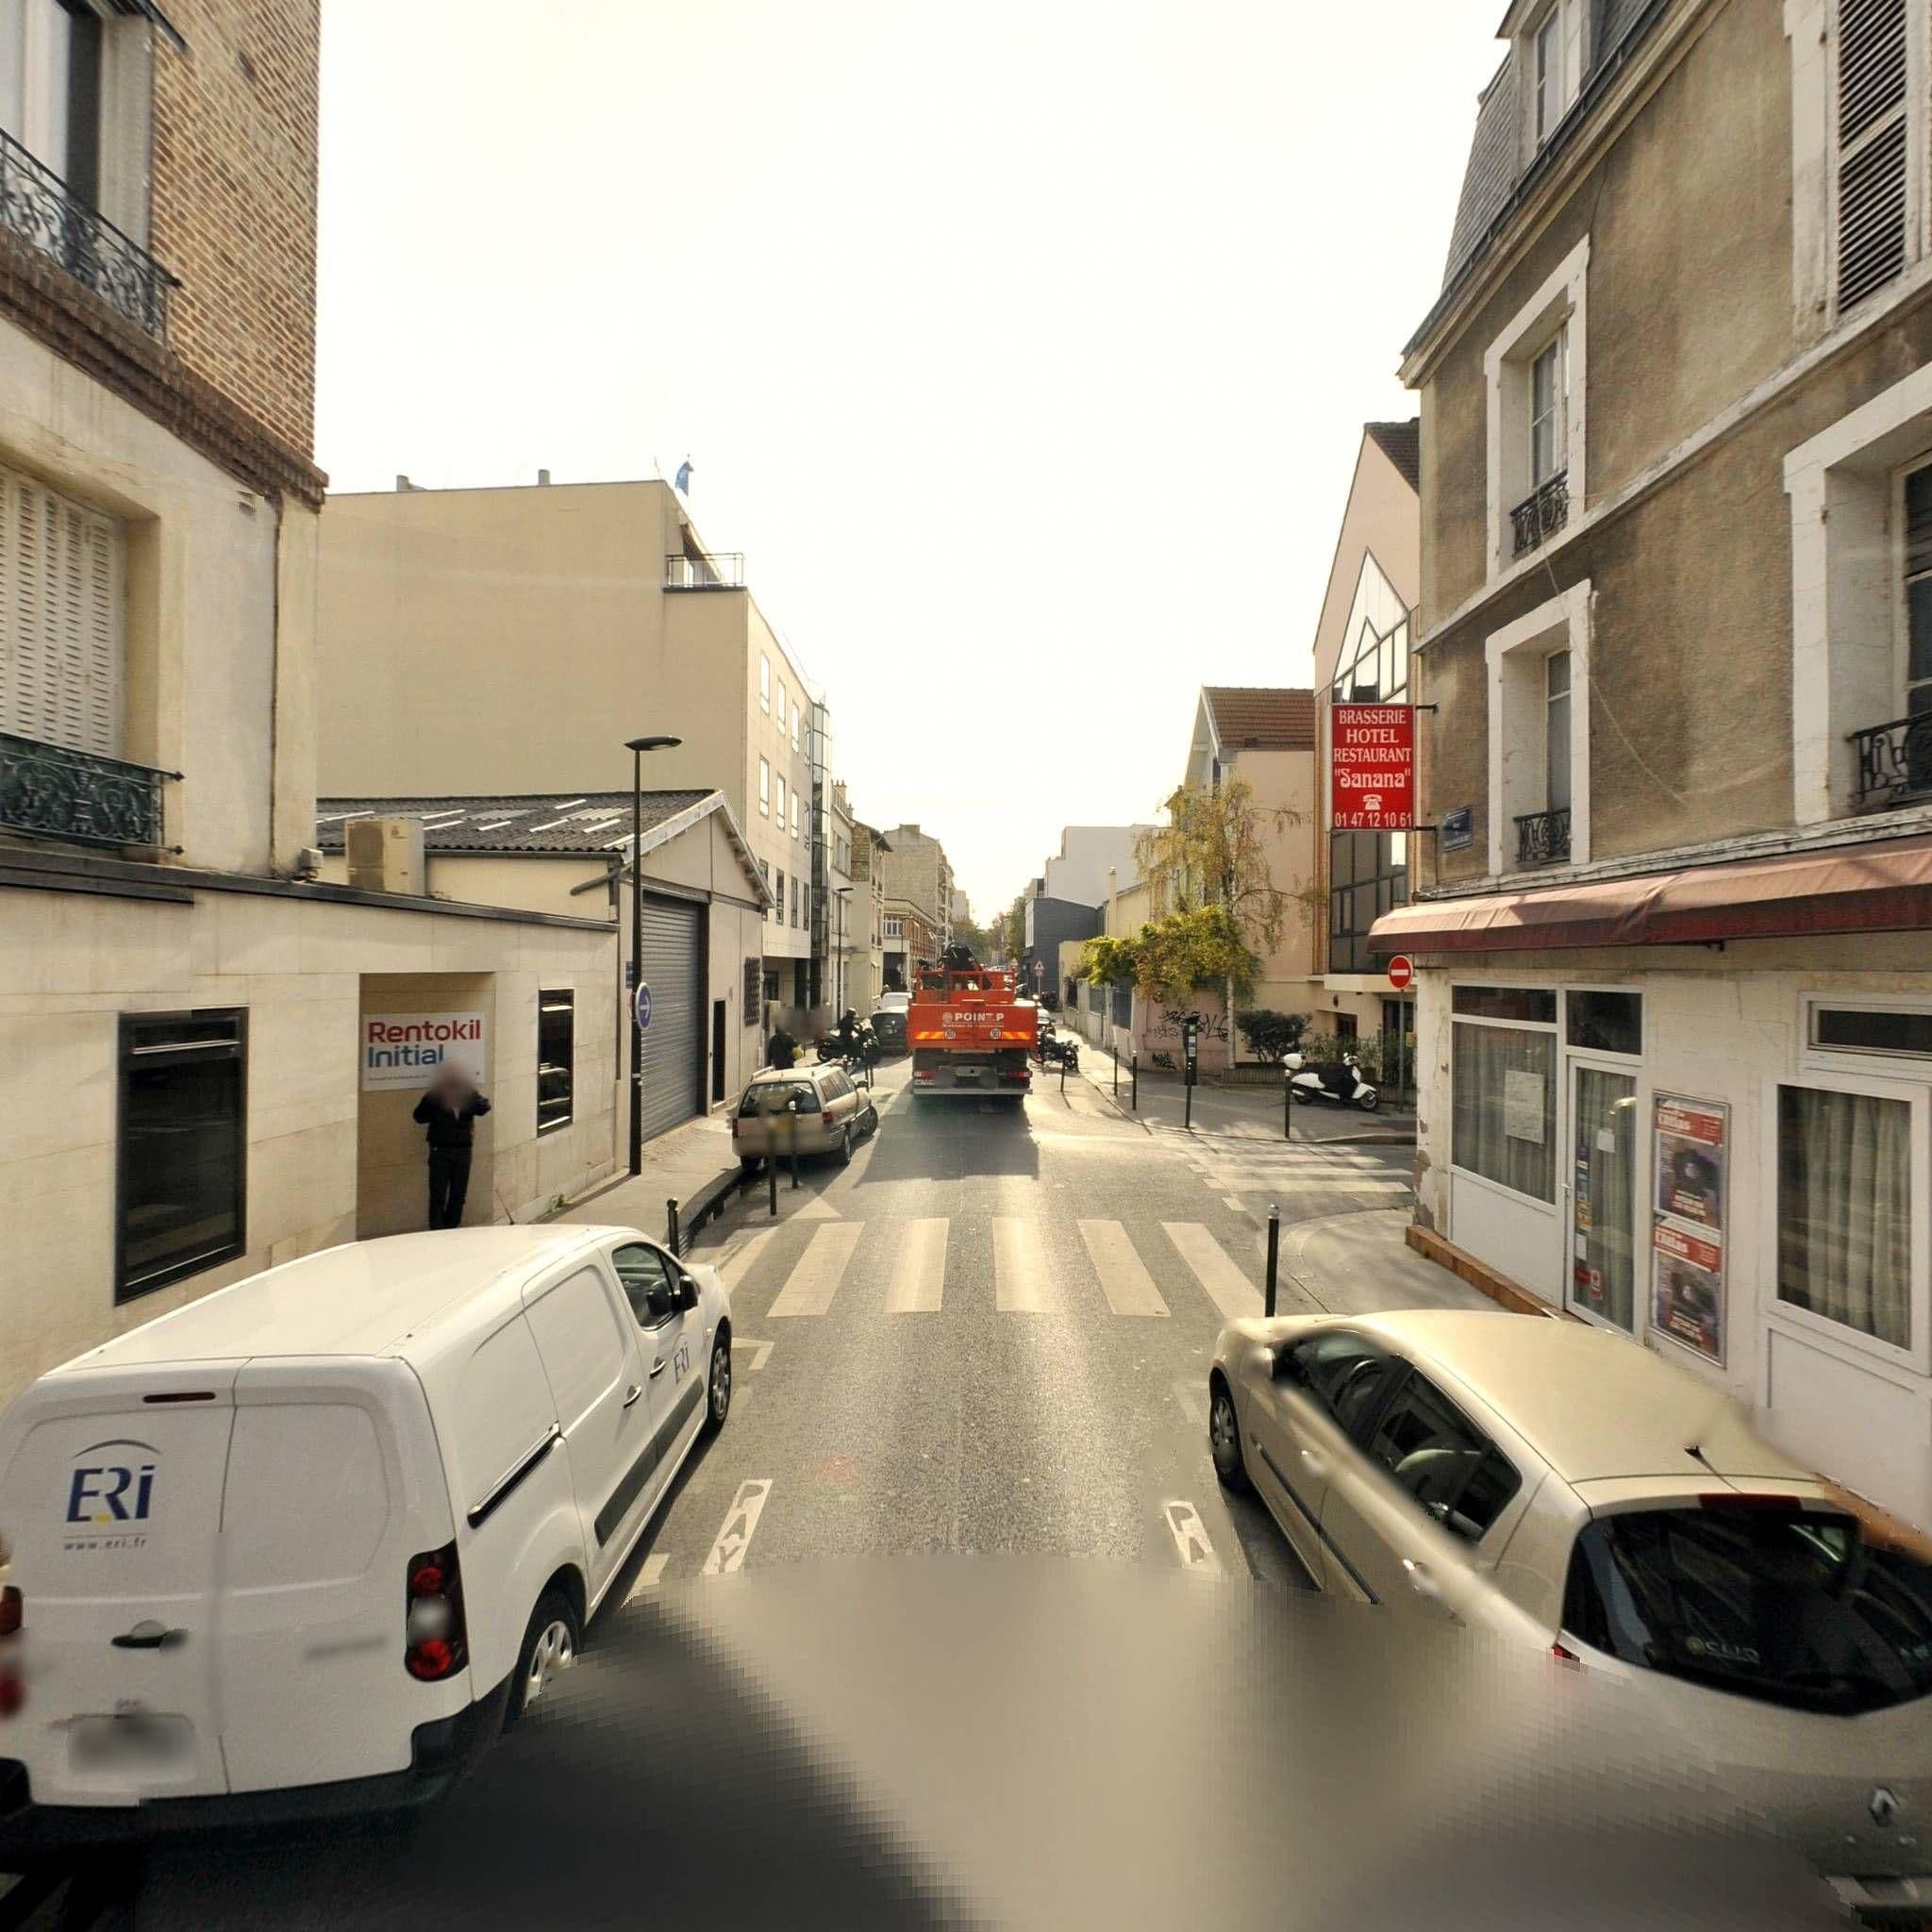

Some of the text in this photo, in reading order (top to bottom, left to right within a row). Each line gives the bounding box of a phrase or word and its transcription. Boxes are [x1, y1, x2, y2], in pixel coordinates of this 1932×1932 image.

[1339, 709, 1407, 724] BRASSERIE
[1346, 728, 1399, 743] HOTEL
[1333, 747, 1412, 762] RESTAURANT
[1335, 812, 1412, 827] 01 47 12 10 61
[368, 1019, 481, 1043] Rentokil
[368, 1044, 444, 1068] Initial
